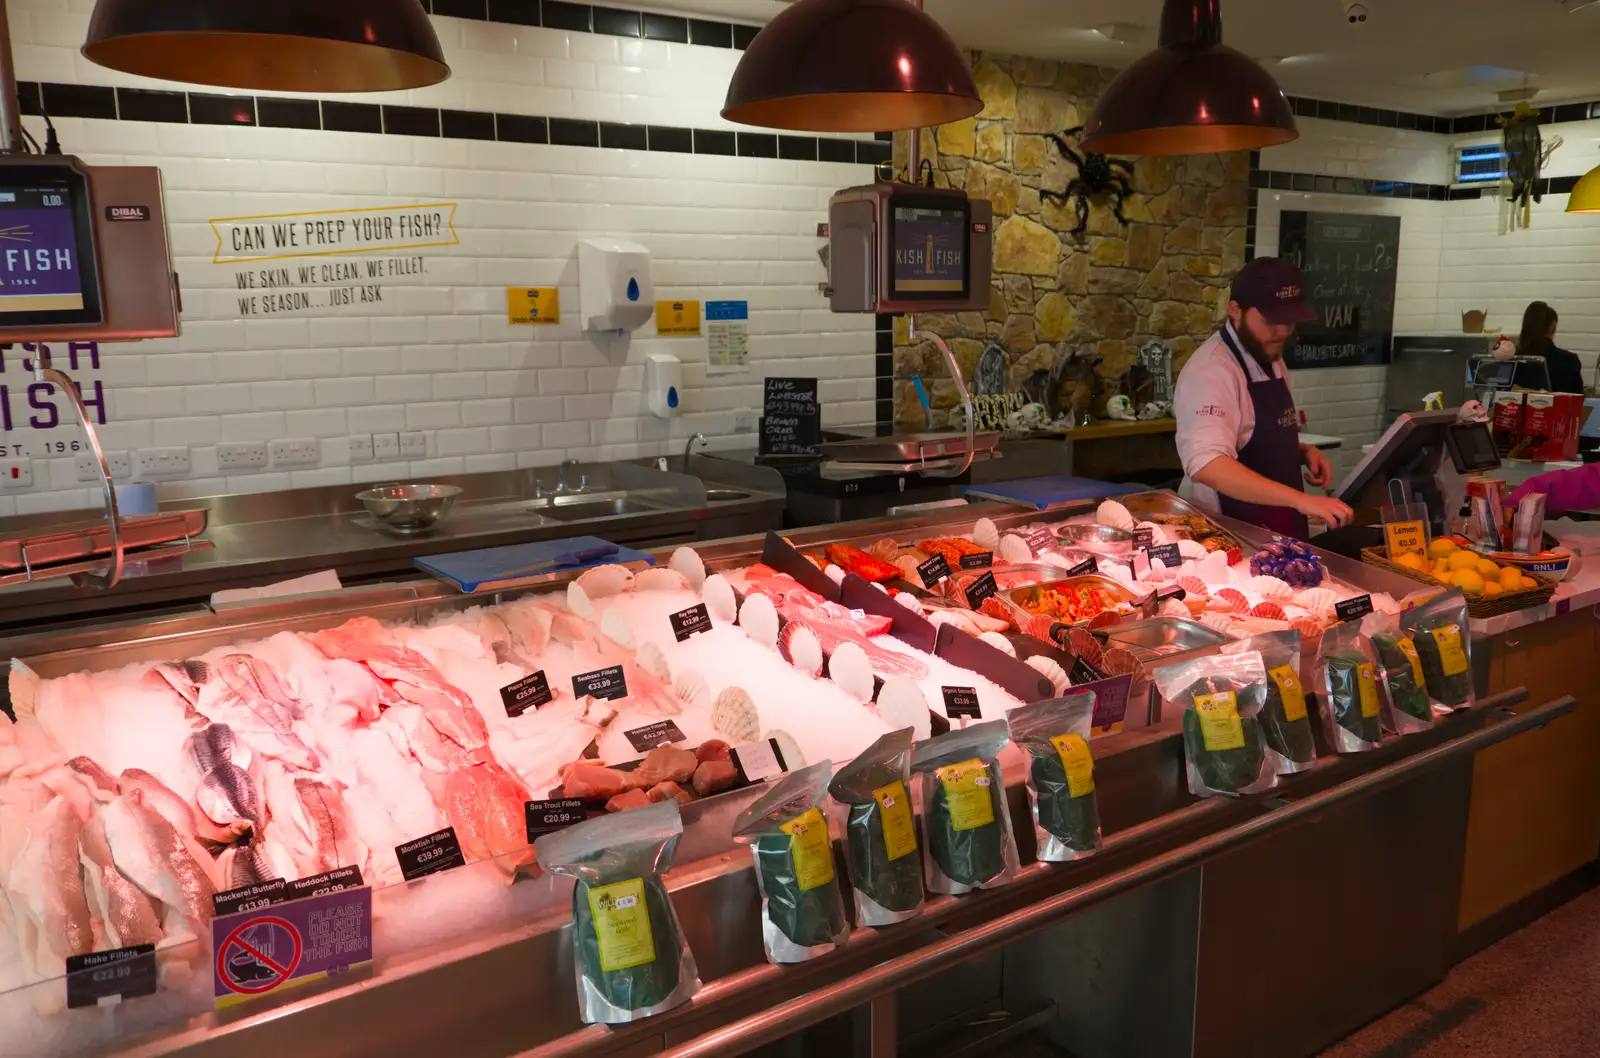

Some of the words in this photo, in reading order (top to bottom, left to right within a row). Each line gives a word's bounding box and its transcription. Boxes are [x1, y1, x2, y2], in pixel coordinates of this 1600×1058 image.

[112, 208, 143, 216] DIBAL
[232, 225, 265, 251] CAN
[272, 222, 299, 249] WE
[305, 220, 345, 245] PREP
[352, 216, 393, 241] YOUR
[399, 213, 441, 238] FISH?
[6, 249, 72, 271] FISH
[896, 249, 923, 265] KISH
[936, 250, 961, 265] FISH
[235, 271, 255, 289] WE
[260, 268, 295, 288] SKIN.
[298, 266, 316, 284] WE
[321, 262, 362, 283] CLEAN.
[366, 260, 384, 278] WE
[388, 257, 427, 276] FILLET.
[238, 297, 257, 315] WE
[262, 291, 324, 314] SEASON...
[328, 287, 355, 307] JUST
[360, 284, 383, 303] ASK
[1325, 303, 1354, 328] VAN
[0, 381, 107, 430] ISH
[0, 444, 30, 457] ST.
[45, 440, 89, 454] 196
[1393, 525, 1418, 535] Lemon
[1399, 538, 1417, 547] €0.50
[1533, 563, 1556, 572] RNLI
[508, 682, 523, 692] Plaice
[523, 675, 538, 685] Fillets
[577, 673, 601, 683] Seabass
[601, 668, 618, 676] Fillets
[588, 679, 611, 690] €33.99
[516, 687, 537, 700] €25.99
[530, 803, 542, 811] Sea
[562, 800, 581, 808] Fillets
[543, 813, 570, 823] €20.99
[401, 839, 431, 854] Monkfish
[431, 831, 451, 844] Fillets
[417, 847, 443, 863] €39.99
[294, 876, 329, 890] Haddock
[330, 868, 353, 880] Fillets
[215, 889, 251, 904] Mackerel
[252, 881, 285, 894] Butterfly
[312, 883, 344, 897] €22.99
[238, 898, 270, 913] €13.99
[308, 901, 364, 925] PLEASE
[308, 920, 331, 937] DO
[333, 914, 363, 931] NOT
[311, 926, 361, 948] TOUCH
[84, 955, 108, 966] Hake
[110, 949, 138, 962] Fillets
[304, 944, 333, 963] THE
[335, 936, 368, 955] FISH
